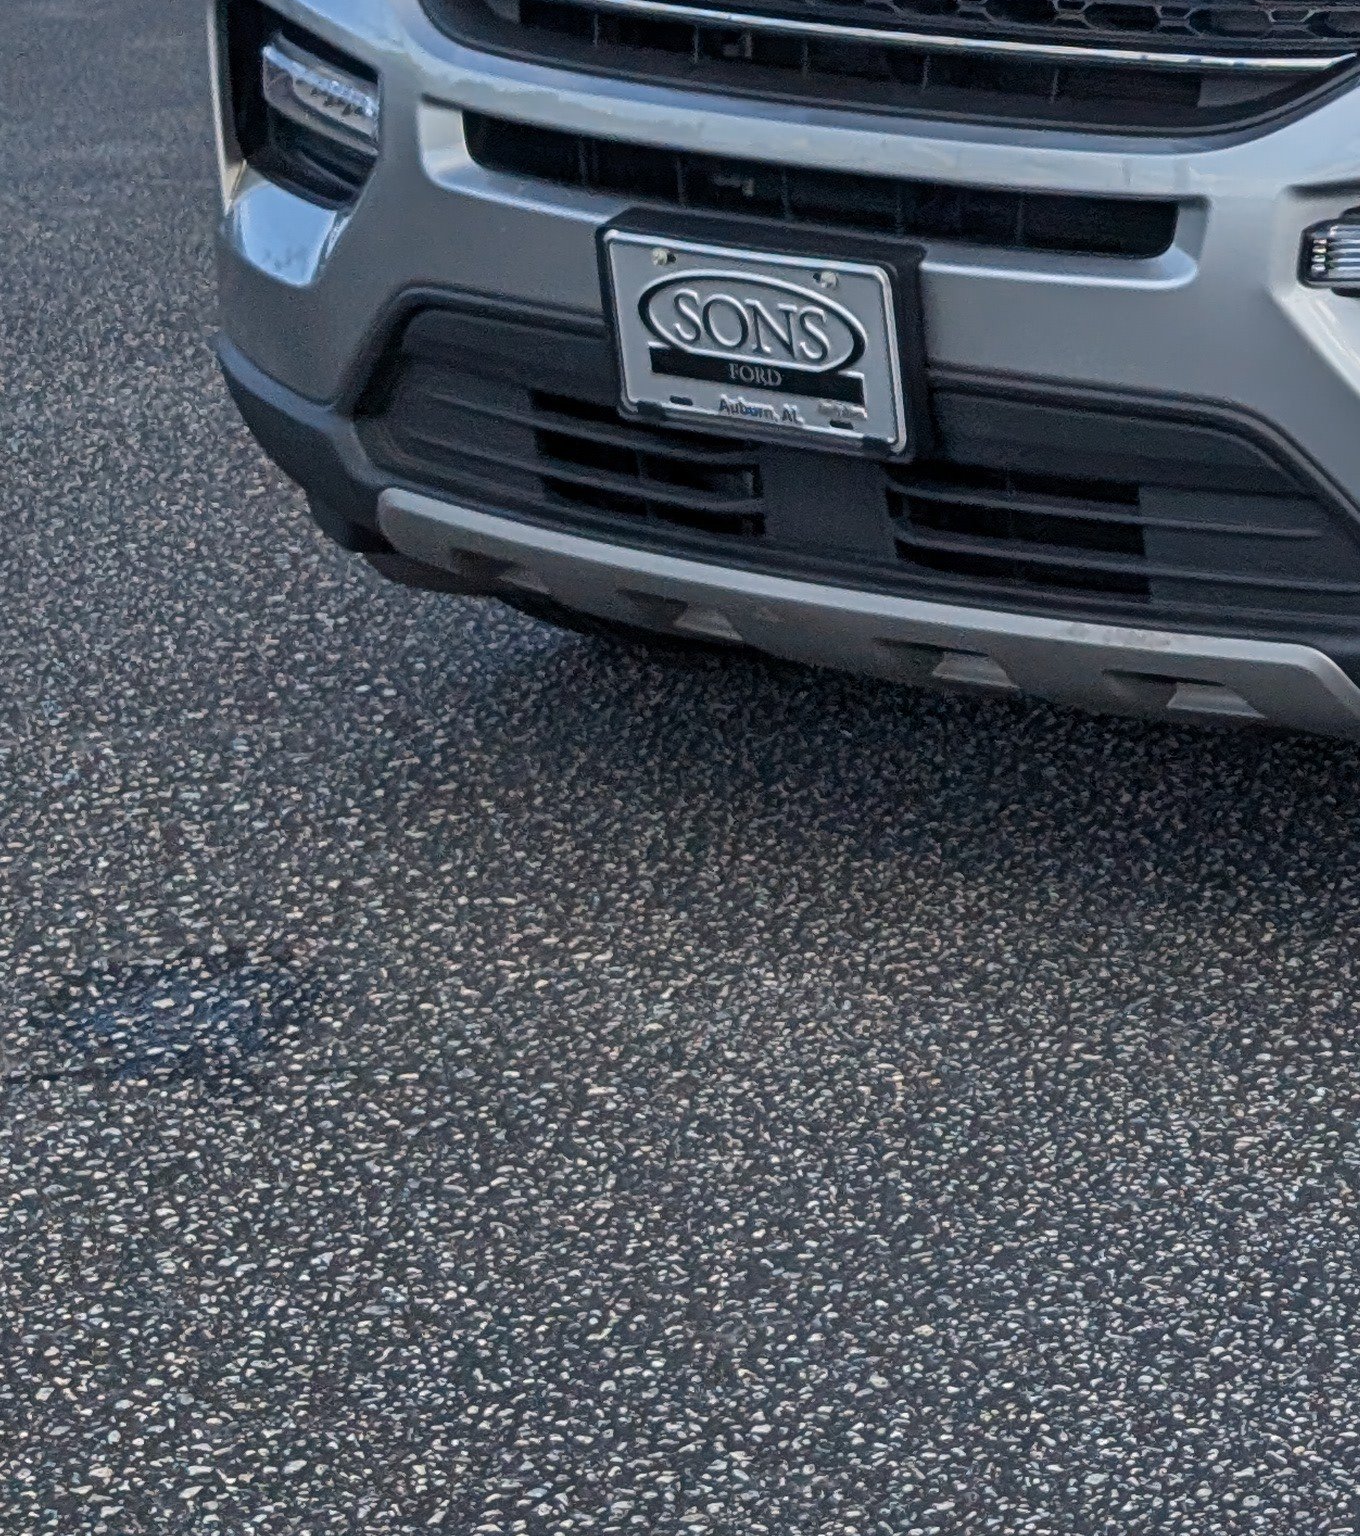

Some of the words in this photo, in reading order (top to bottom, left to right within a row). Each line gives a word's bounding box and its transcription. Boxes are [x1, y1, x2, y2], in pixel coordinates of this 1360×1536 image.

[672, 288, 831, 363] SONS
[728, 362, 783, 387] FORD
[781, 403, 805, 425] AL
